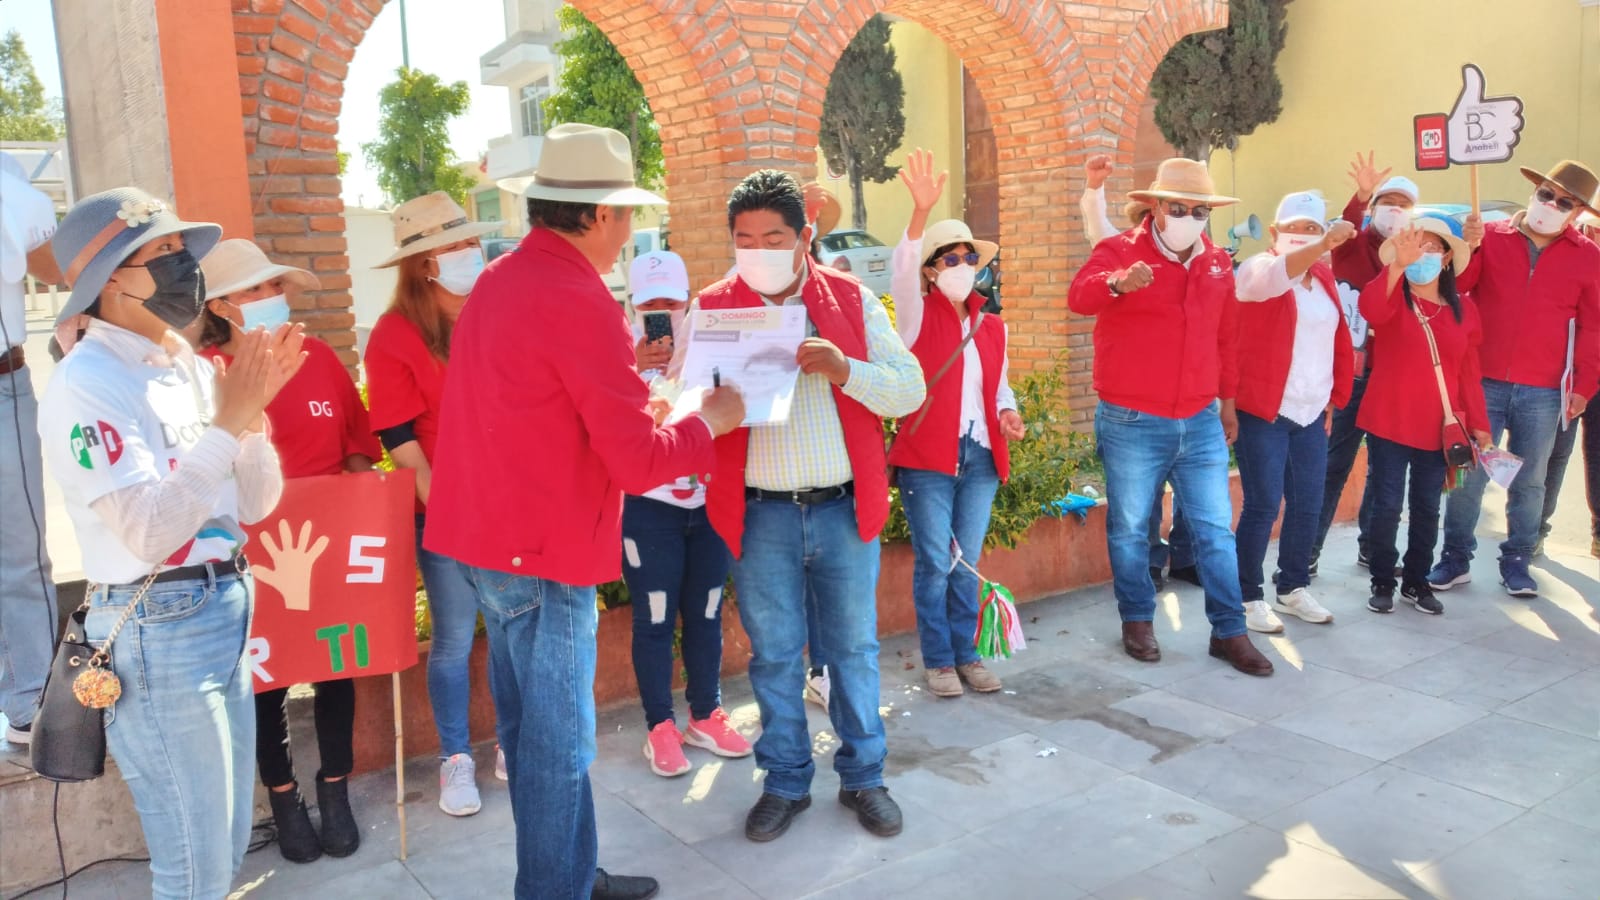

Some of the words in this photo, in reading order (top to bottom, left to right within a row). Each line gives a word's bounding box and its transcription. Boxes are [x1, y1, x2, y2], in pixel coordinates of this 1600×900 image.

[721, 311, 766, 320] DOMINGO
[308, 400, 333, 417] DG
[70, 420, 124, 470] PRI
[316, 623, 370, 673] TI
